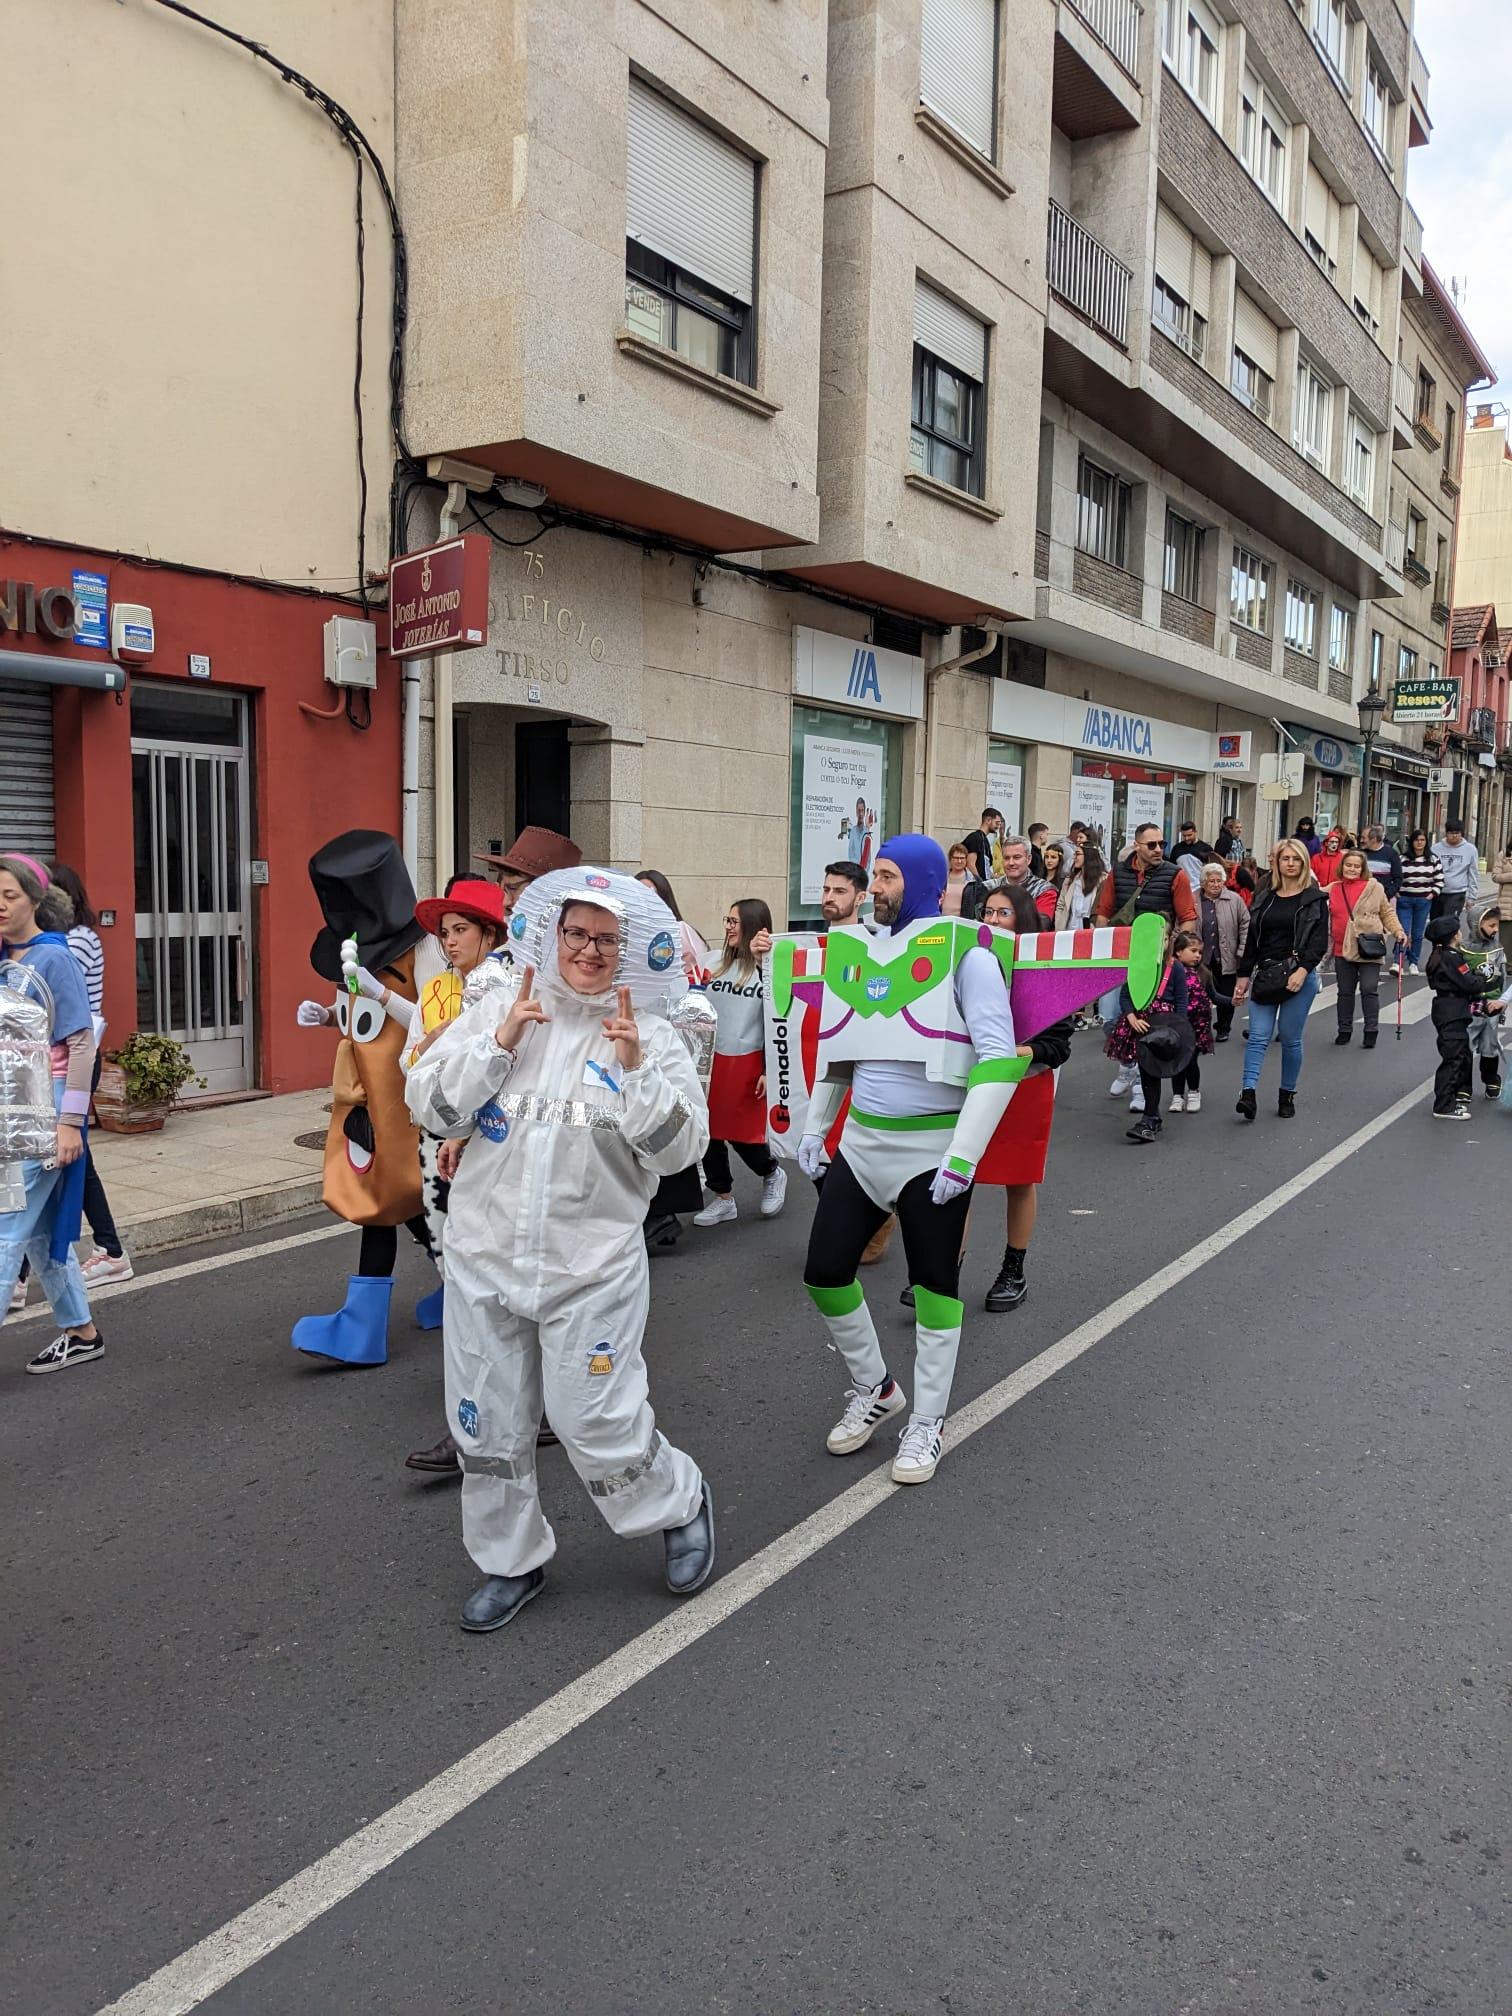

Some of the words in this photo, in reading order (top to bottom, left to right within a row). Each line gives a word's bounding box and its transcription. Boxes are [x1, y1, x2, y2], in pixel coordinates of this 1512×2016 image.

[633, 289, 661, 317] VENDE
[523, 551, 545, 579] 75
[417, 589, 461, 619] ANTONIO
[402, 618, 450, 649] JOYERÍAS
[195, 664, 206, 673] 73
[496, 650, 569, 684] TIRSO
[530, 691, 539, 699] 75
[1396, 695, 1447, 707] Resero
[828, 757, 849, 773] Seguro
[850, 774, 867, 789] Fogar
[771, 1017, 790, 1123] Frenadol
[480, 1117, 506, 1131] NASA
